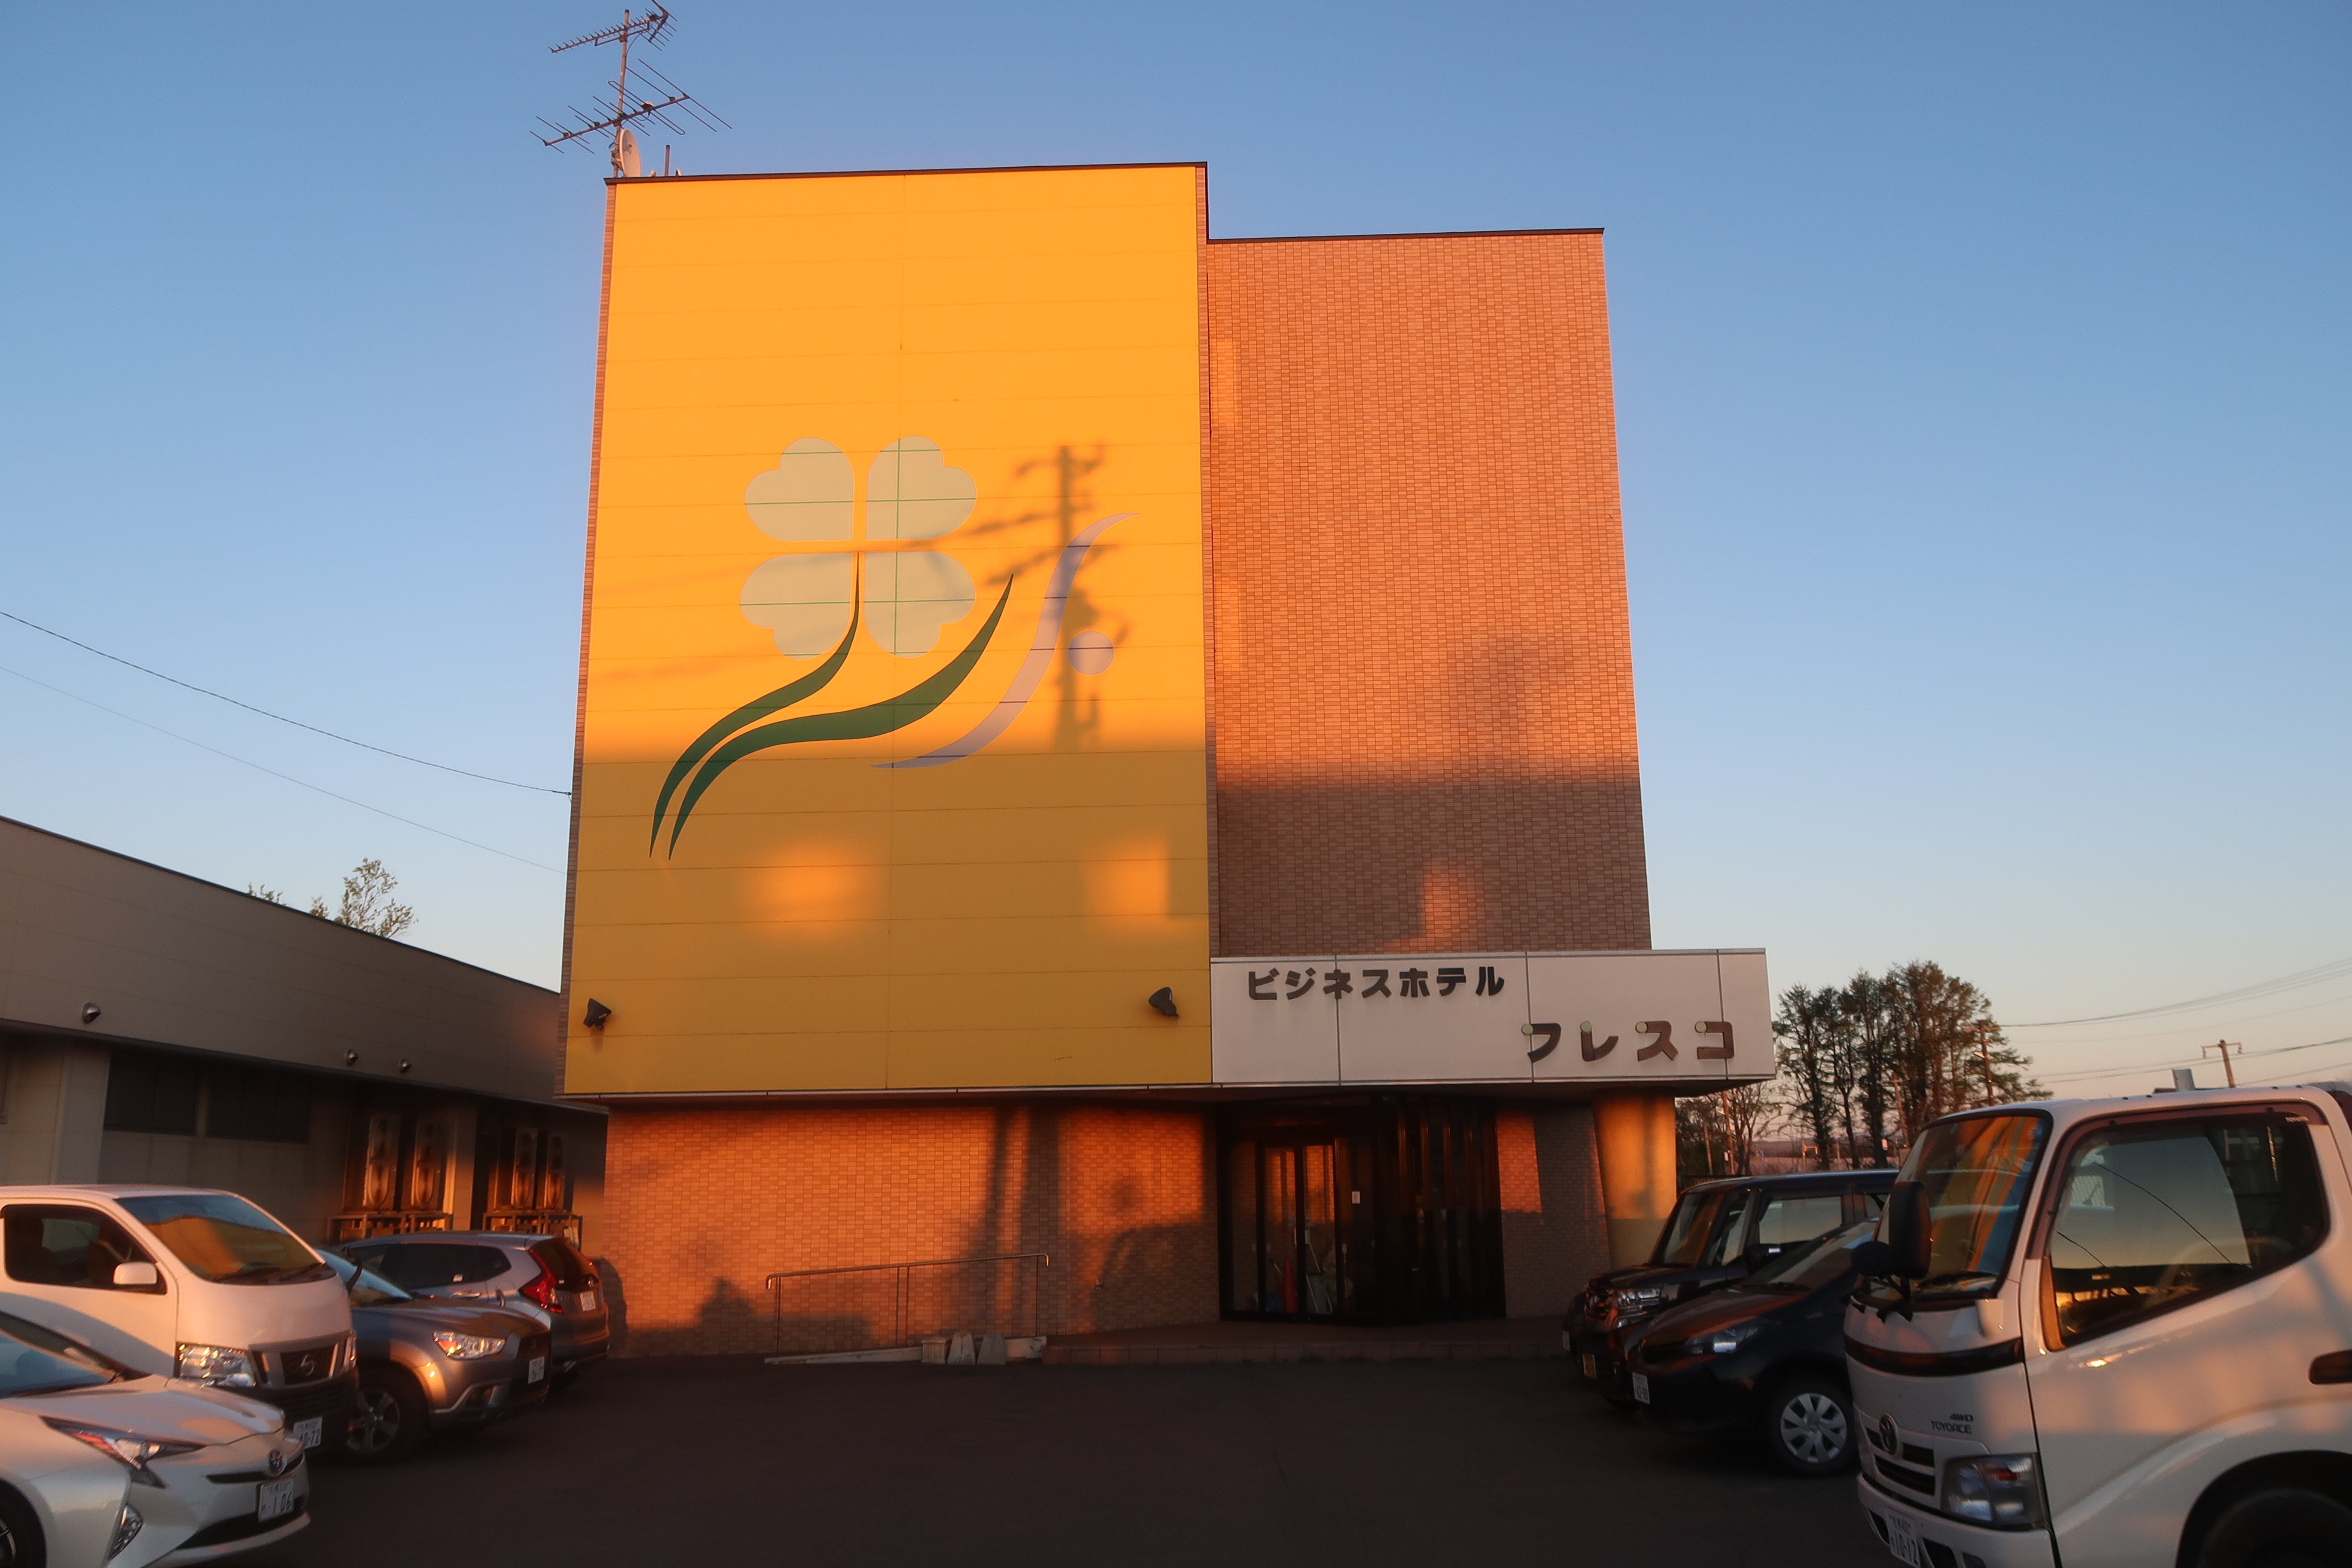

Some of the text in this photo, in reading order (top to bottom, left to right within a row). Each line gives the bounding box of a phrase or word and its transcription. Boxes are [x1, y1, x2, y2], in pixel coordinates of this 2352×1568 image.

[1249, 967, 1504, 1000] ビジネスホテル
[1521, 1021, 1734, 1063] フレスコ
[1931, 1420, 1972, 1434] TOYOACE
[1950, 1413, 1973, 1422] 4WD
